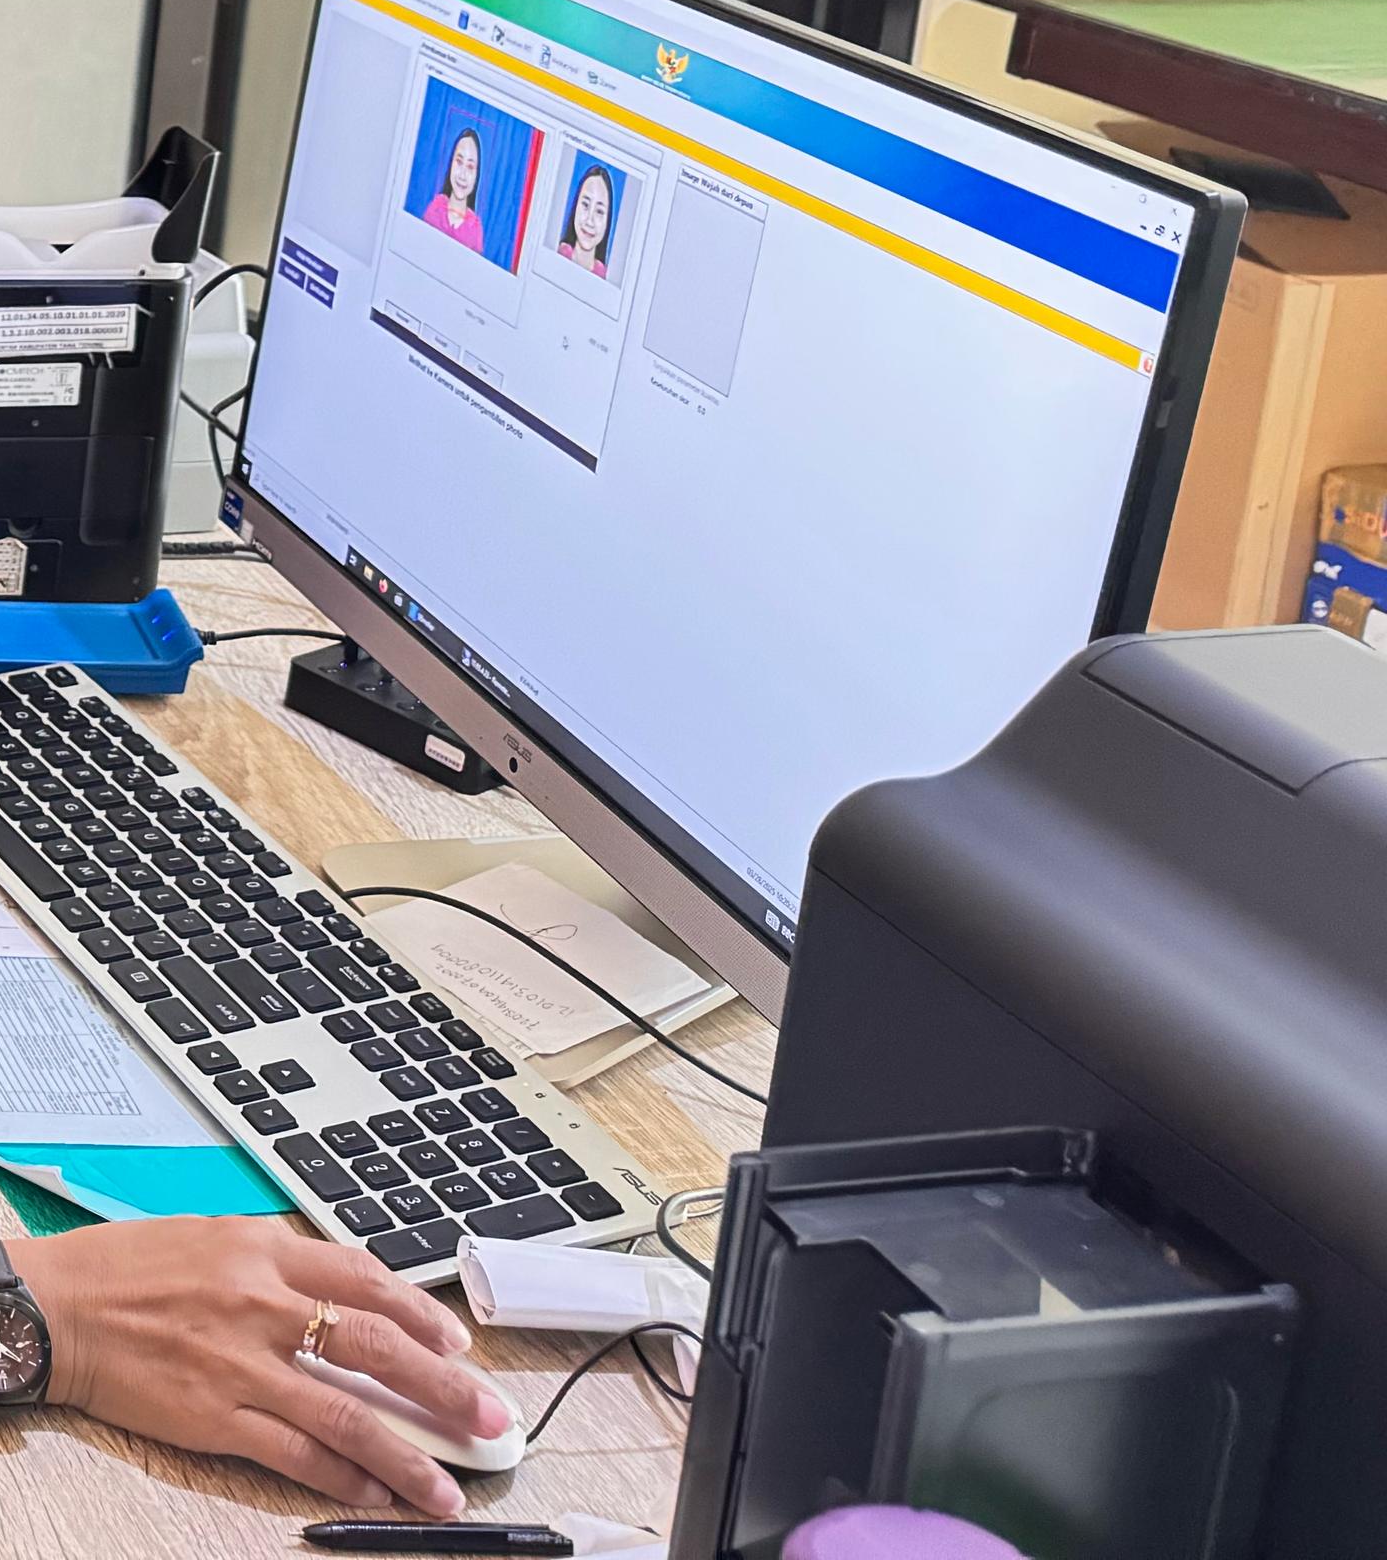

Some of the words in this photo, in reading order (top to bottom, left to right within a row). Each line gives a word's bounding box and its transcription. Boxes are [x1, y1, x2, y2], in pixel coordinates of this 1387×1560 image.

[14, 711, 29, 720] Q
[35, 728, 51, 738] W
[1, 742, 16, 750] S
[21, 762, 36, 770] D
[43, 782, 58, 790] F
[99, 790, 114, 798] T
[14, 800, 29, 808] V
[64, 803, 79, 812] G
[121, 811, 136, 819] Y
[34, 822, 50, 830] B
[144, 833, 159, 841] U
[56, 844, 73, 852] N
[78, 866, 95, 876] M
[131, 869, 147, 878] K
[192, 877, 207, 886] O
[216, 902, 232, 910] P
[435, 1108, 451, 1116] 7
[468, 1139, 483, 1148] 8
[420, 1152, 437, 1160] 5
[375, 1163, 389, 1172] 2
[501, 1171, 517, 1180] 9
[453, 1184, 471, 1193] 6
[613, 1167, 664, 1206] ASUS
[405, 1196, 422, 1206] 3
